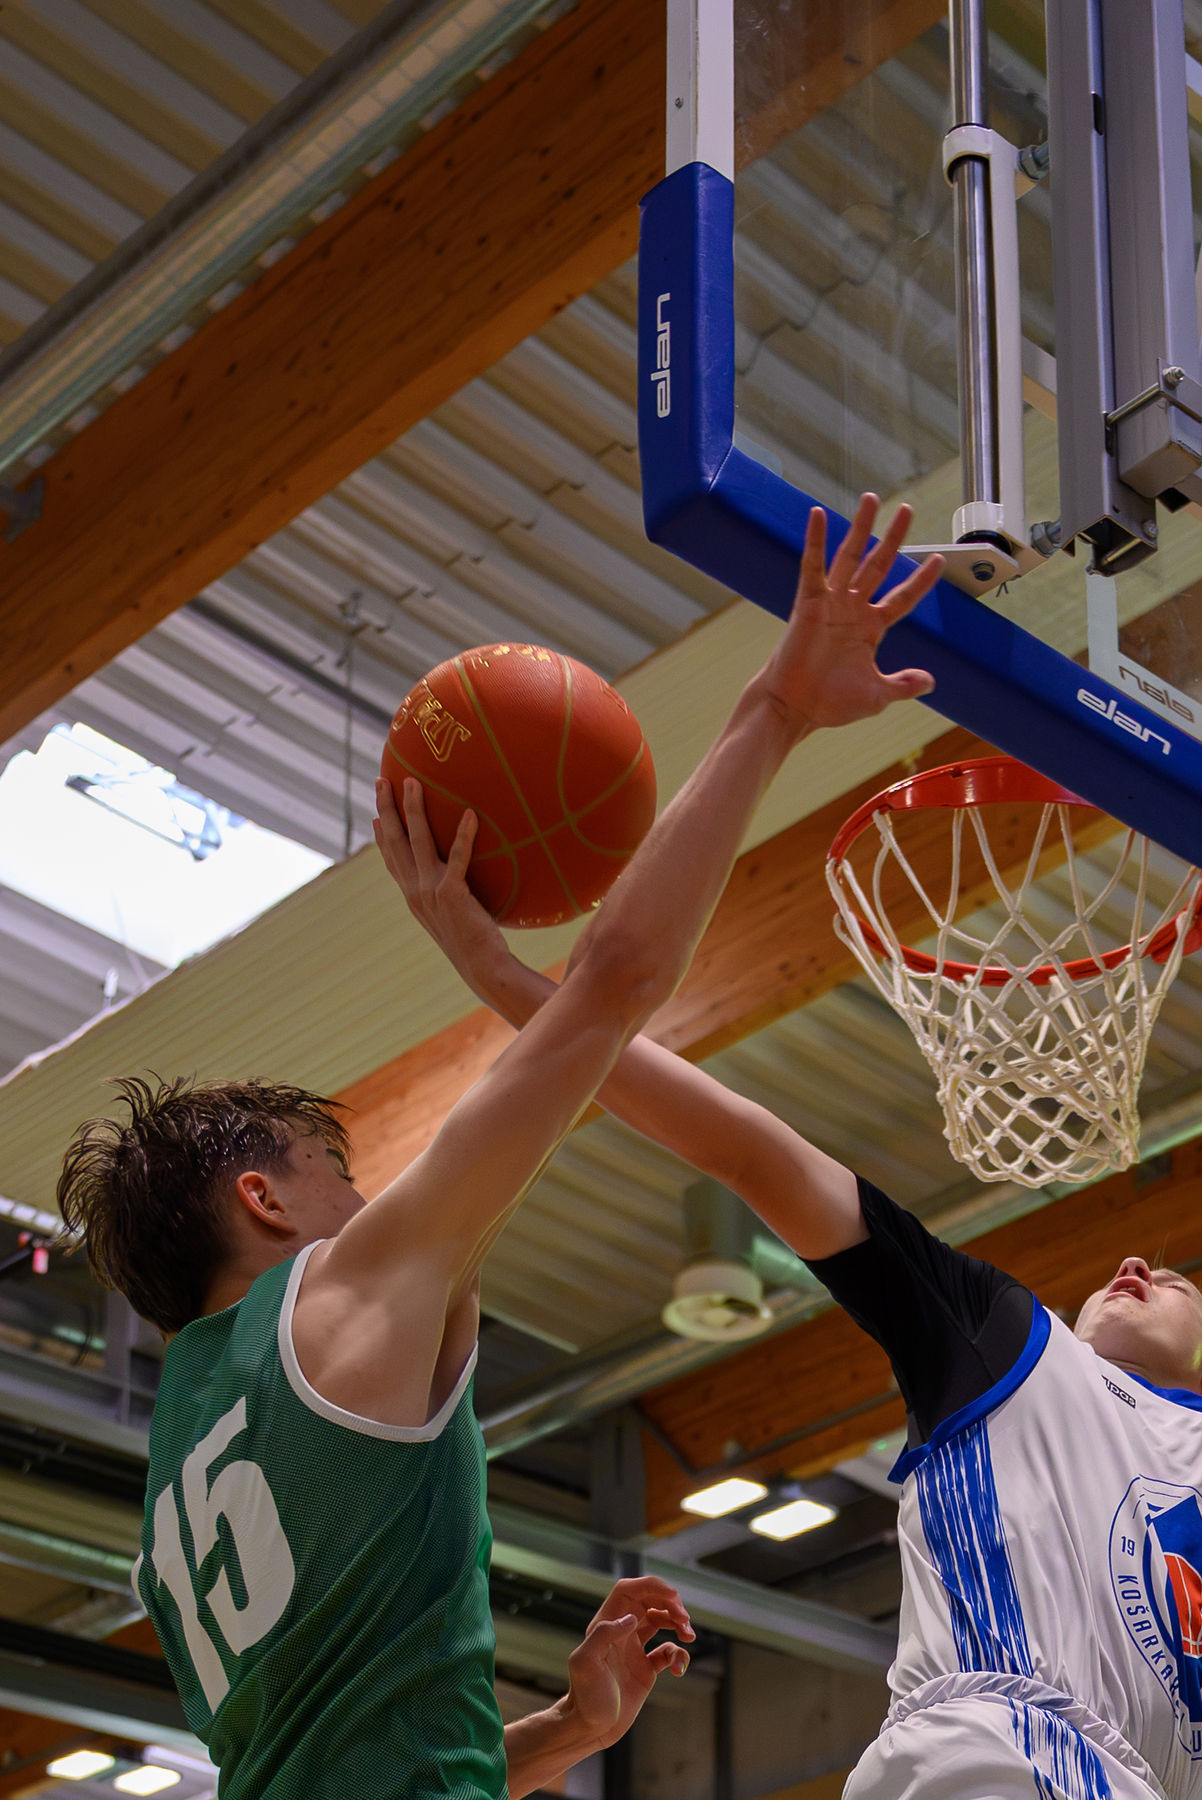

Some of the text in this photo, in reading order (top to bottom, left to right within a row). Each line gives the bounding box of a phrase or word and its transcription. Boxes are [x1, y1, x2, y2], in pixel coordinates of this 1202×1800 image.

[650, 293, 671, 418] elan
[1076, 688, 1172, 755] elan
[131, 1396, 296, 1715] 15
[1120, 1536, 1136, 1557] 19
